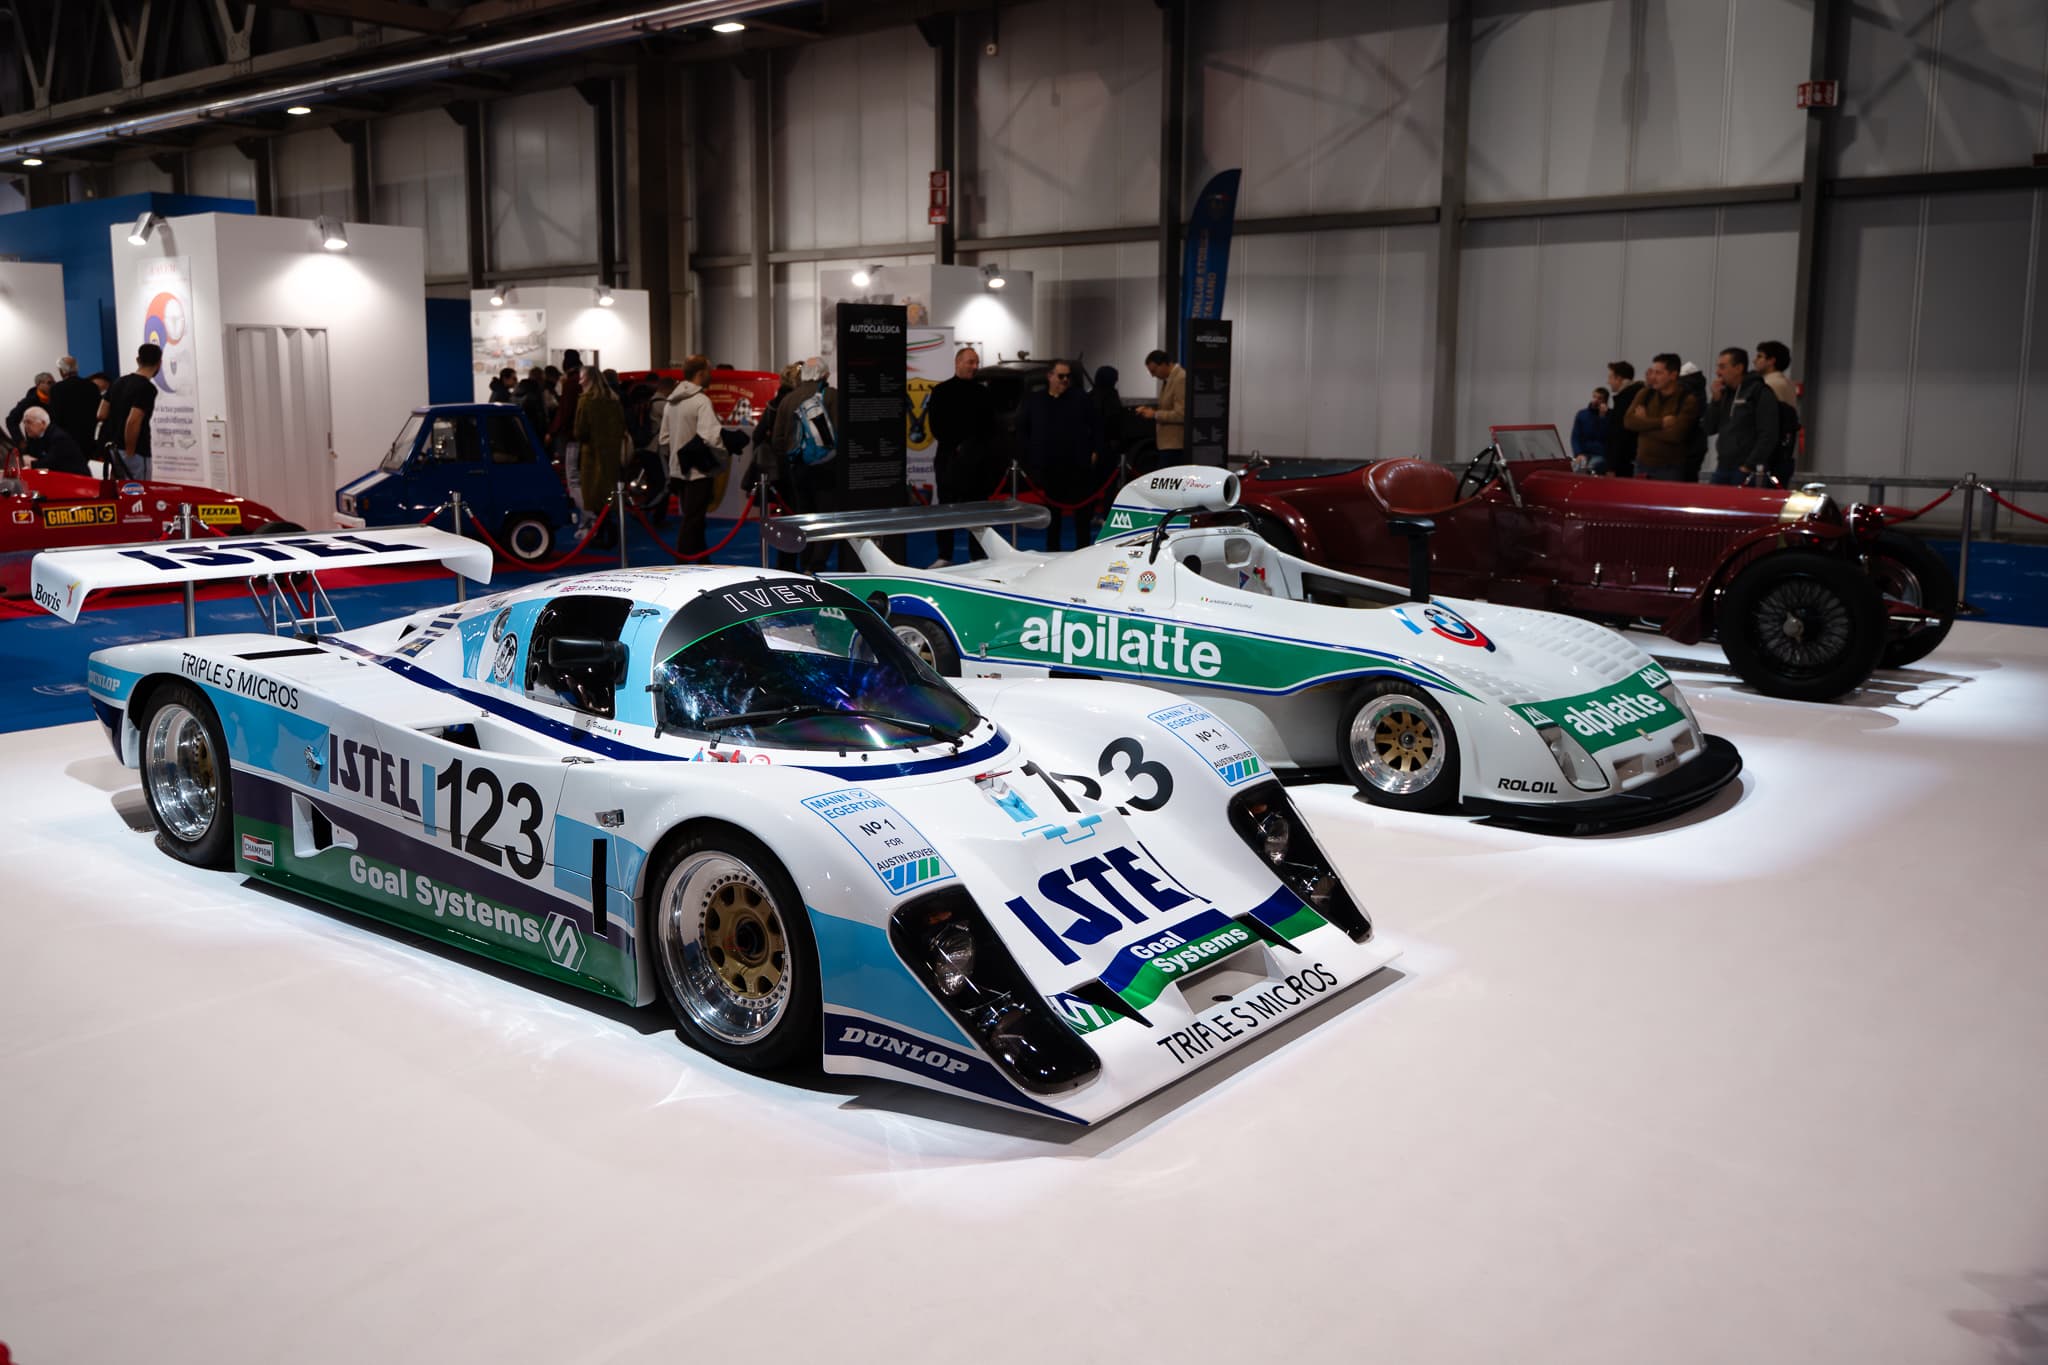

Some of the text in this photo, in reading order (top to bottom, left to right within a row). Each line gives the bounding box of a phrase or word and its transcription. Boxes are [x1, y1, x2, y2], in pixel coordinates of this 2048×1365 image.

[849, 324, 900, 334] AUTOCLASSICA
[1150, 477, 1212, 491] BMW Power
[47, 507, 94, 525] GIRLING
[201, 507, 237, 515] TEXTAR
[118, 535, 427, 570] ISTEL
[35, 583, 61, 613] Bovis
[723, 585, 823, 613] IVEY
[1019, 610, 1222, 677] alpilatte
[88, 670, 121, 692] DUNLOP
[182, 652, 299, 710] TRIPLE S MICROS
[1154, 708, 1184, 723] MANN
[1166, 711, 1211, 730] EGERTON
[1563, 692, 1666, 737] alpilatte
[1211, 728, 1223, 739] 1
[1215, 742, 1228, 751] FOR
[1213, 750, 1253, 769] AUSTIN ROVER
[330, 734, 421, 817] ISTEL
[1497, 777, 1558, 794] ROLOIL
[810, 793, 851, 809] MANN
[823, 798, 888, 820] EGERTON
[437, 758, 544, 880] 123
[883, 818, 896, 831] 1
[244, 841, 272, 858] CHAMPION
[884, 837, 904, 848] FOR
[876, 847, 936, 872] AUSTIN ROVER
[350, 855, 541, 944] Goal Systems
[1004, 841, 1211, 966] ISTE
[1129, 930, 1188, 961] Goal
[1151, 926, 1250, 974] Systems
[1156, 962, 1338, 1065] TRIPLE S MICROS
[838, 1026, 970, 1075] DUNLOP
